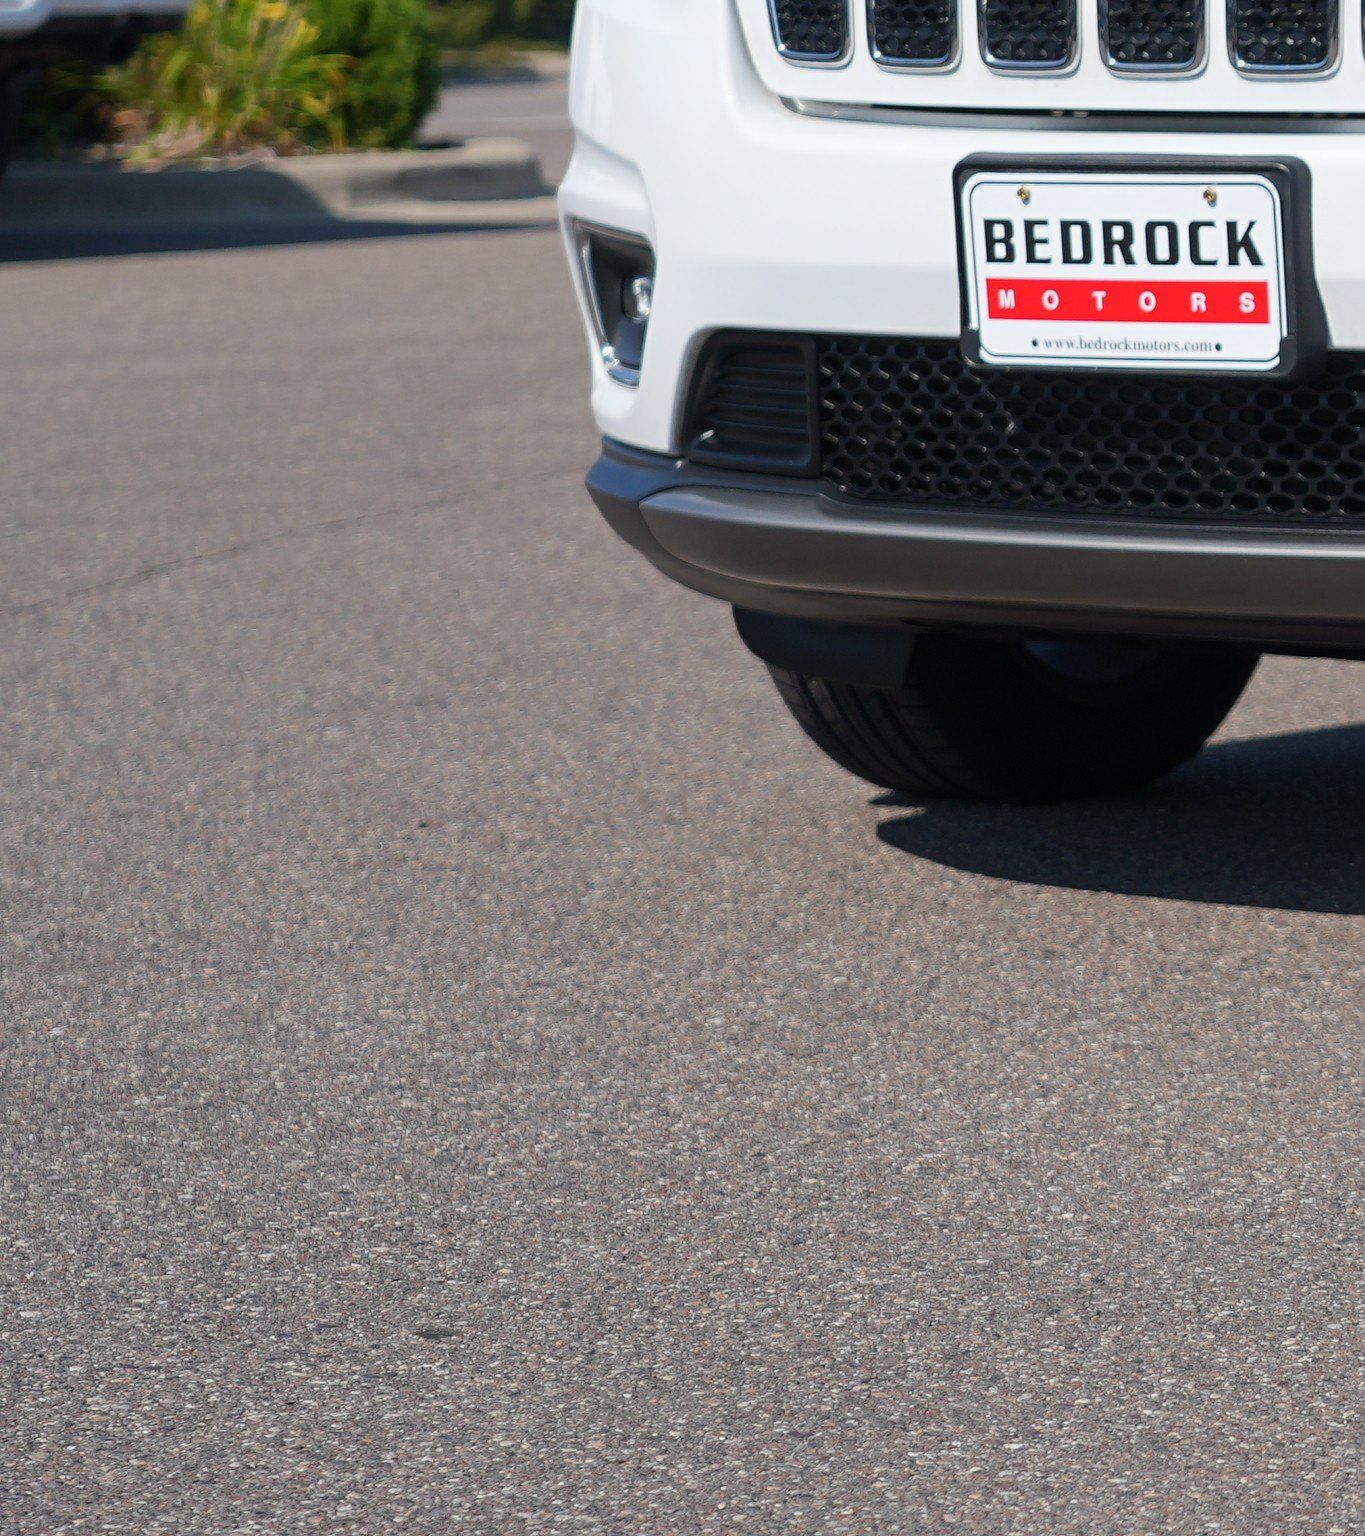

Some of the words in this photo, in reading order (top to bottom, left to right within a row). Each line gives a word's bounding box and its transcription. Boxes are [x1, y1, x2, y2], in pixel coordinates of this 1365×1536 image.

[983, 219, 1266, 266] BEDROCK
[998, 289, 1257, 313] MOTORS
[1043, 336, 1213, 353] www.bedrockmotors.com
